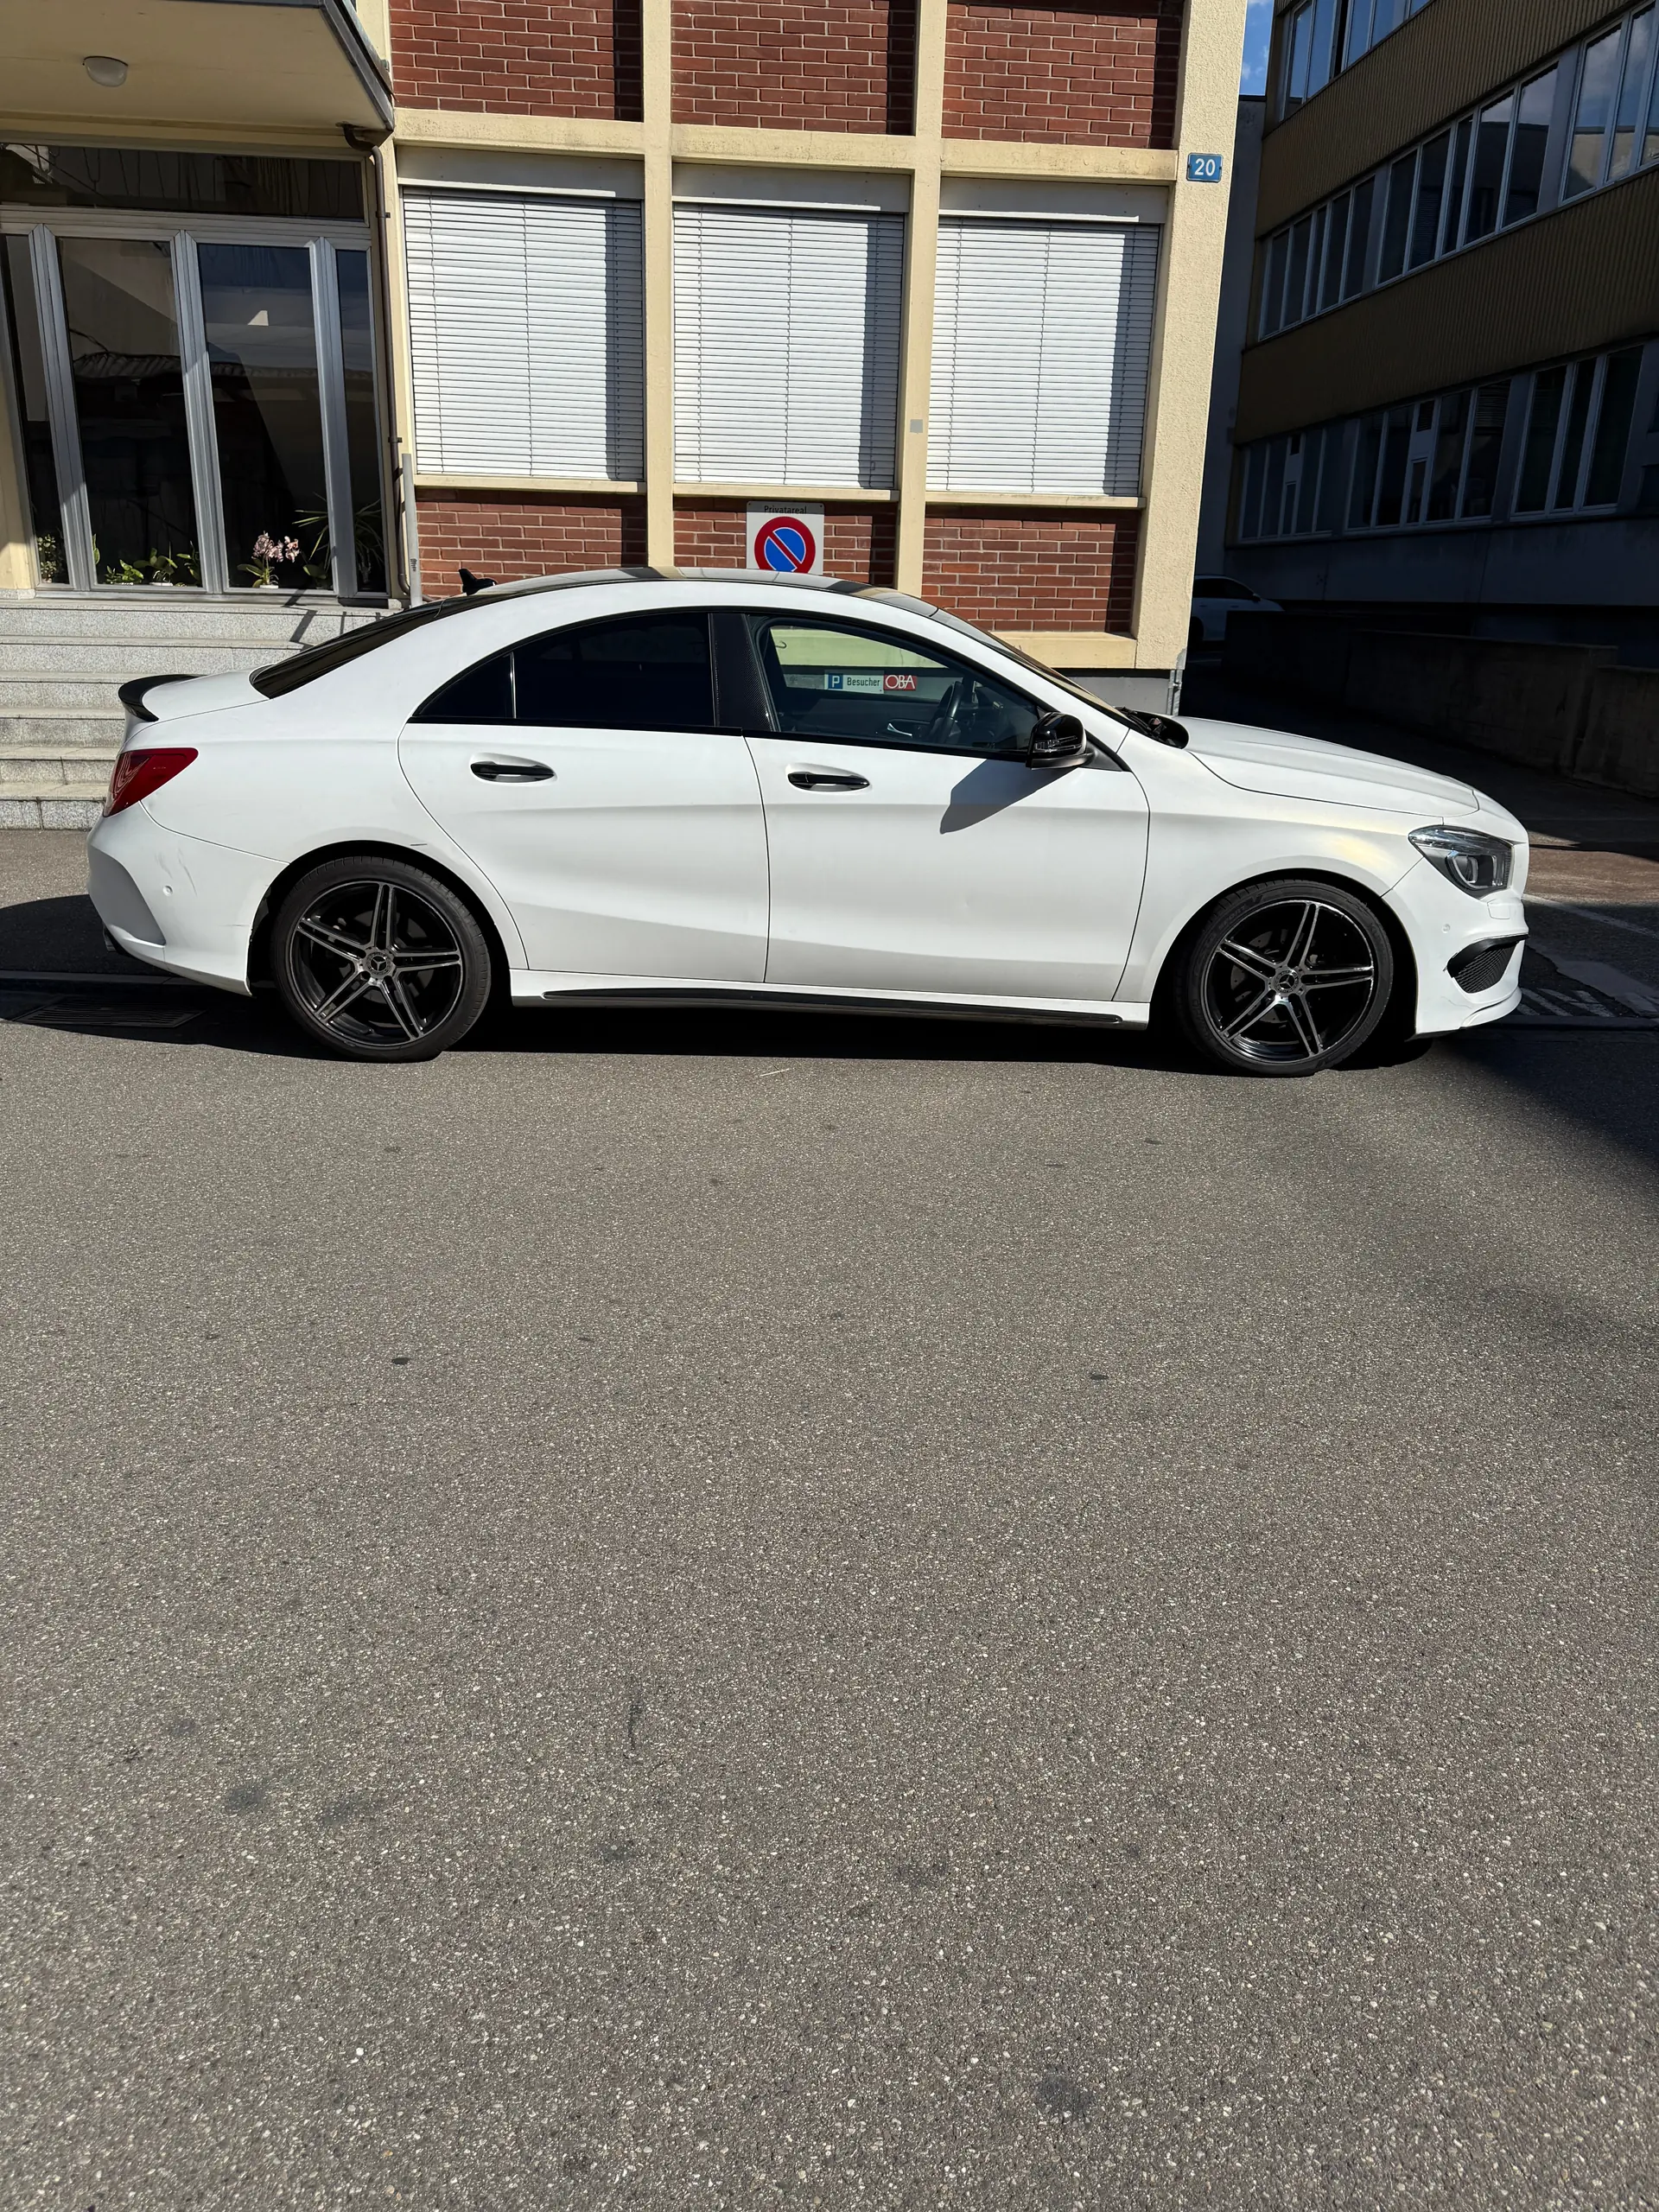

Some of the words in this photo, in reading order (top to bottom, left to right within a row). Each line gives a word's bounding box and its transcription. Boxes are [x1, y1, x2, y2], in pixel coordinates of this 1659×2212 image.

[1194, 158, 1216, 176] 20
[764, 505, 807, 515] Privatareal
[832, 676, 840, 688] P
[847, 677, 880, 687] Besucher
[885, 675, 916, 689] OBA
